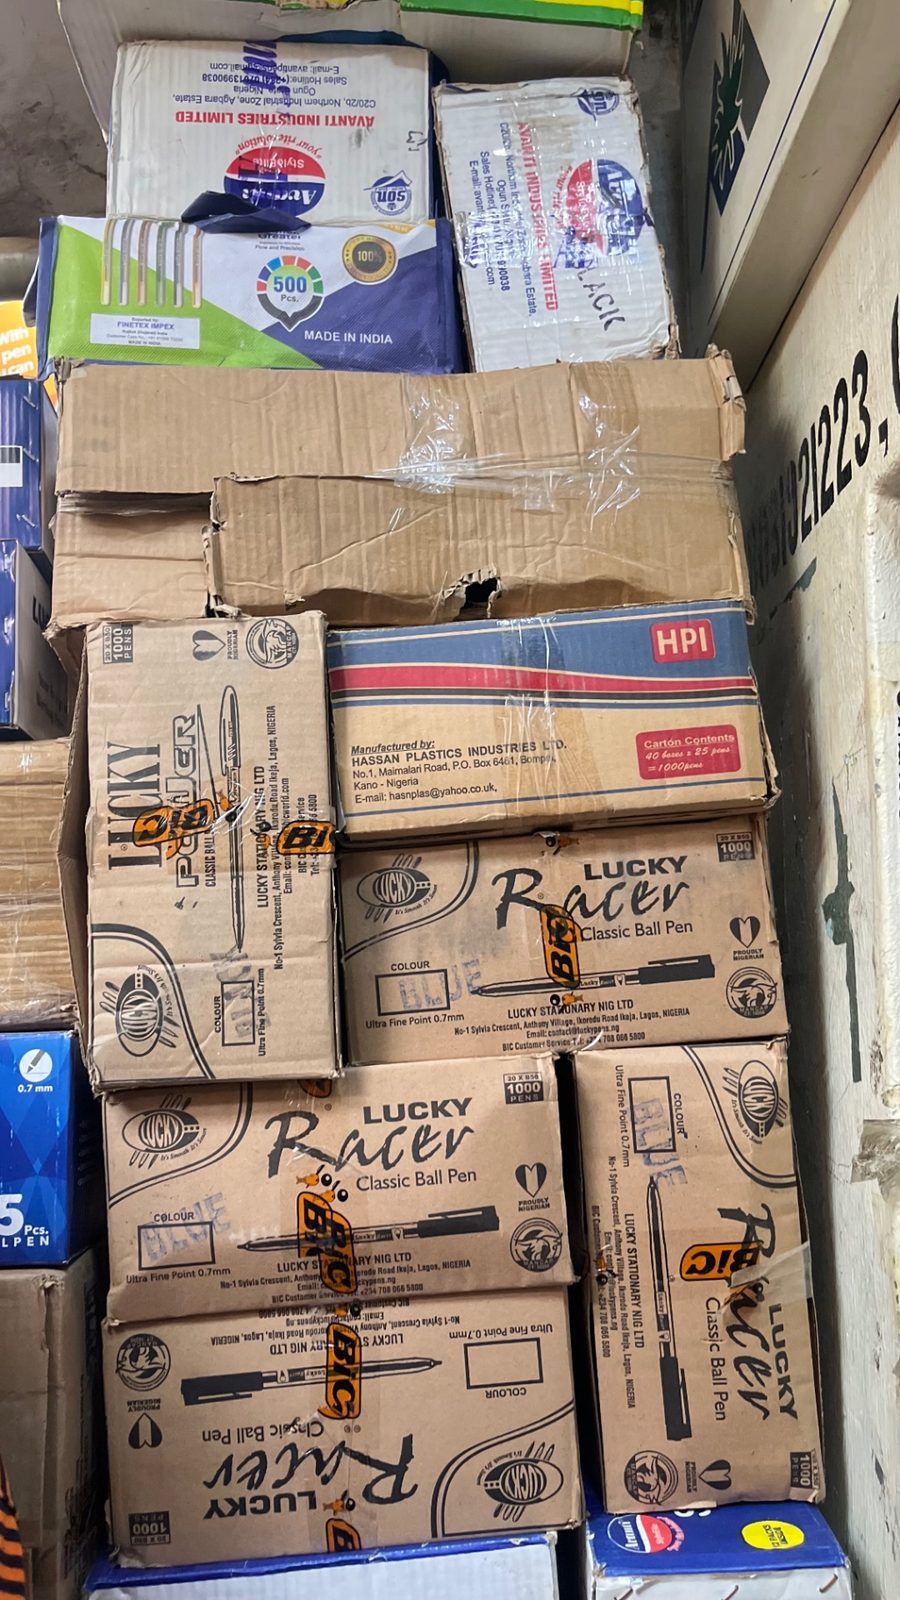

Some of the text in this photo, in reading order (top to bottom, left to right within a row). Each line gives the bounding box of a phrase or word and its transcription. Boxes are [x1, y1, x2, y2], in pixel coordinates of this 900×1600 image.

[292, 87, 316, 97] Ogun
[324, 77, 347, 86] Sales
[173, 94, 202, 104] Estate,
[204, 95, 236, 106] Agbara
[176, 110, 376, 128] AVANTI INDUSTRIES LIMITED
[480, 151, 491, 178] Sales
[274, 276, 308, 294] 500
[280, 294, 299, 303] Pcs.
[116, 321, 175, 330] FINETEX IMPEX
[304, 330, 394, 345] MADE IN INDIA
[112, 627, 124, 661] 1000
[124, 628, 132, 660] PENS
[656, 626, 708, 656] HPI
[266, 705, 277, 733] NIGERIA
[351, 740, 435, 756] Manufactured by:
[644, 734, 735, 749] Carton Contents
[352, 753, 400, 767] HASSAN
[406, 748, 463, 763] PLASTICS
[468, 742, 537, 758] INDUSTRIES
[352, 768, 377, 780] No.1,
[378, 765, 422, 778] Maimalari
[424, 762, 451, 774] Road,
[452, 760, 472, 770] P.O.
[473, 758, 492, 769] Box
[354, 777, 419, 791] Kano Nigeria
[253, 766, 269, 909] LUCKY LTD
[720, 841, 752, 854] 1000
[204, 855, 216, 888] CLASSIC
[584, 855, 689, 881] LUCKY
[376, 871, 413, 904] LUCKY
[491, 866, 690, 930] Racer
[272, 891, 284, 927] Crescent,
[273, 928, 285, 951] Sylvia
[581, 920, 694, 942] Classic Ball Pen
[273, 952, 284, 970] No-1
[733, 948, 763, 956] PROUDLY
[390, 960, 431, 972] COLOUR
[214, 996, 222, 1033] COLOUR
[258, 996, 266, 1018] Point
[508, 999, 634, 1019] LUCKY NIG LTD
[366, 1014, 465, 1029] Ultra Fine Point 0.7mm
[470, 1008, 691, 1036] Sylvia Crescent, NIGERIA
[18, 1084, 54, 1094] 0.7 mm
[506, 1082, 541, 1095] 1000
[510, 1094, 539, 1103] PENS
[363, 1097, 473, 1125] LUCKY
[615, 1064, 630, 1168] Ultra Fine Point 0.7mm
[674, 1092, 685, 1135] COLOUR
[142, 1114, 180, 1148] LUCKY
[264, 1110, 475, 1179] Racer
[356, 1168, 477, 1192] Classic Ball Pen
[154, 1212, 195, 1223] COLOUR
[24, 1225, 49, 1236] Pcs.
[277, 1252, 412, 1273] LUCKY NIG LTD
[126, 1267, 231, 1285] Ultra Fine Point 0.7mm
[238, 1260, 471, 1289] Sylvia NIGERIA
[624, 1213, 645, 1349] LUCKY STATIONARY NIG LTD
[210, 1336, 240, 1346] NIGERIA
[448, 1323, 553, 1340] Ultra Fine Point 0.7mm
[270, 1333, 404, 1356] LUCKY NIG LTD
[705, 1297, 729, 1421] Classic Ball Pen
[768, 1303, 799, 1420] LUCKY
[485, 1387, 527, 1399] COLOUR
[626, 1378, 636, 1409] NIGERIA
[202, 1424, 264, 1445] Ball Pen
[203, 1433, 419, 1505] Racer
[800, 1454, 811, 1487] 1000
[203, 1490, 318, 1520] LUCKY
[132, 1522, 168, 1536] 1000
